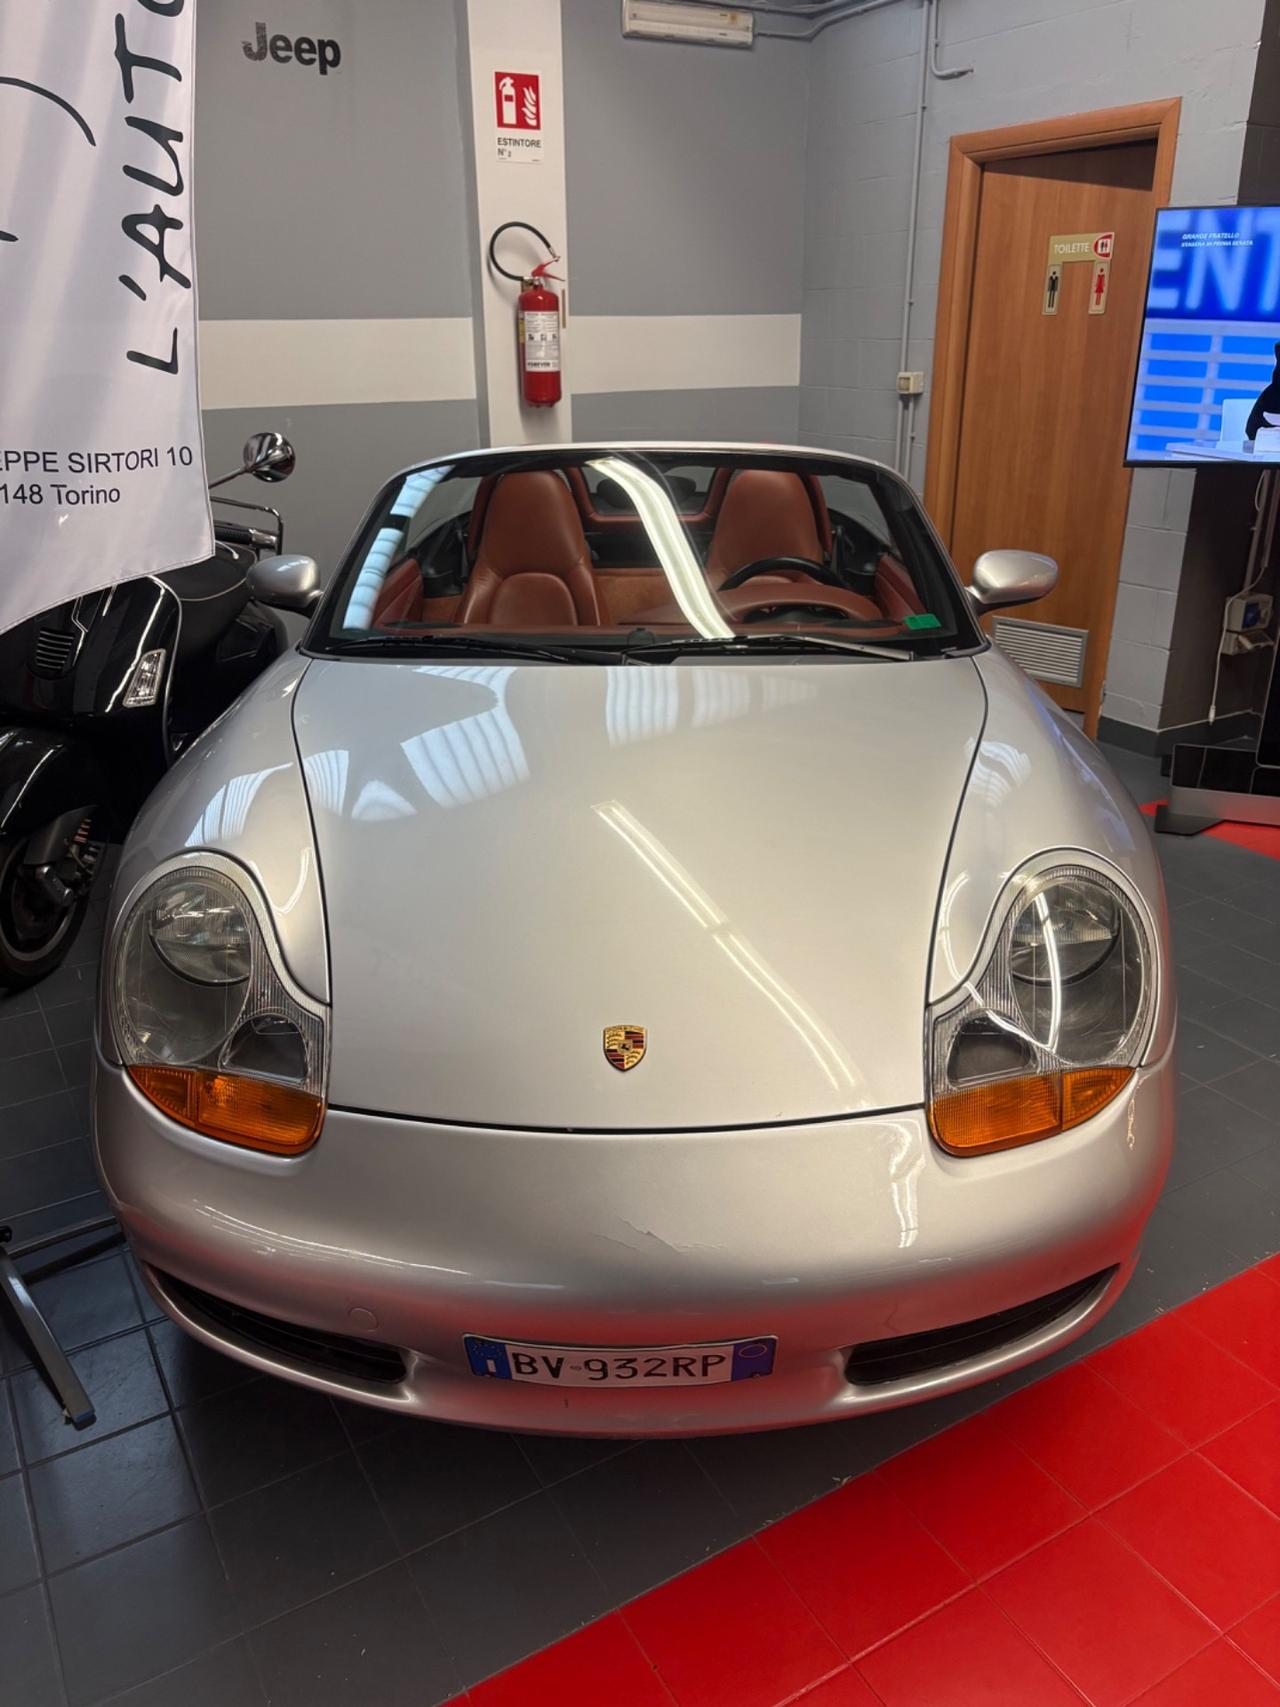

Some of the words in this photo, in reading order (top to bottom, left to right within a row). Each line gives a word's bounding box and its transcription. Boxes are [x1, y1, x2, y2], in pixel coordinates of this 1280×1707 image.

[241, 21, 342, 76] Jeep
[497, 137, 541, 148] ESTINTORE
[1054, 242, 1090, 255] TOILETTE
[0, 450, 59, 473] PPE
[68, 447, 159, 474] SIRTORI
[166, 446, 193, 467] 10
[0, 483, 43, 505] 148
[50, 484, 121, 506] Torino
